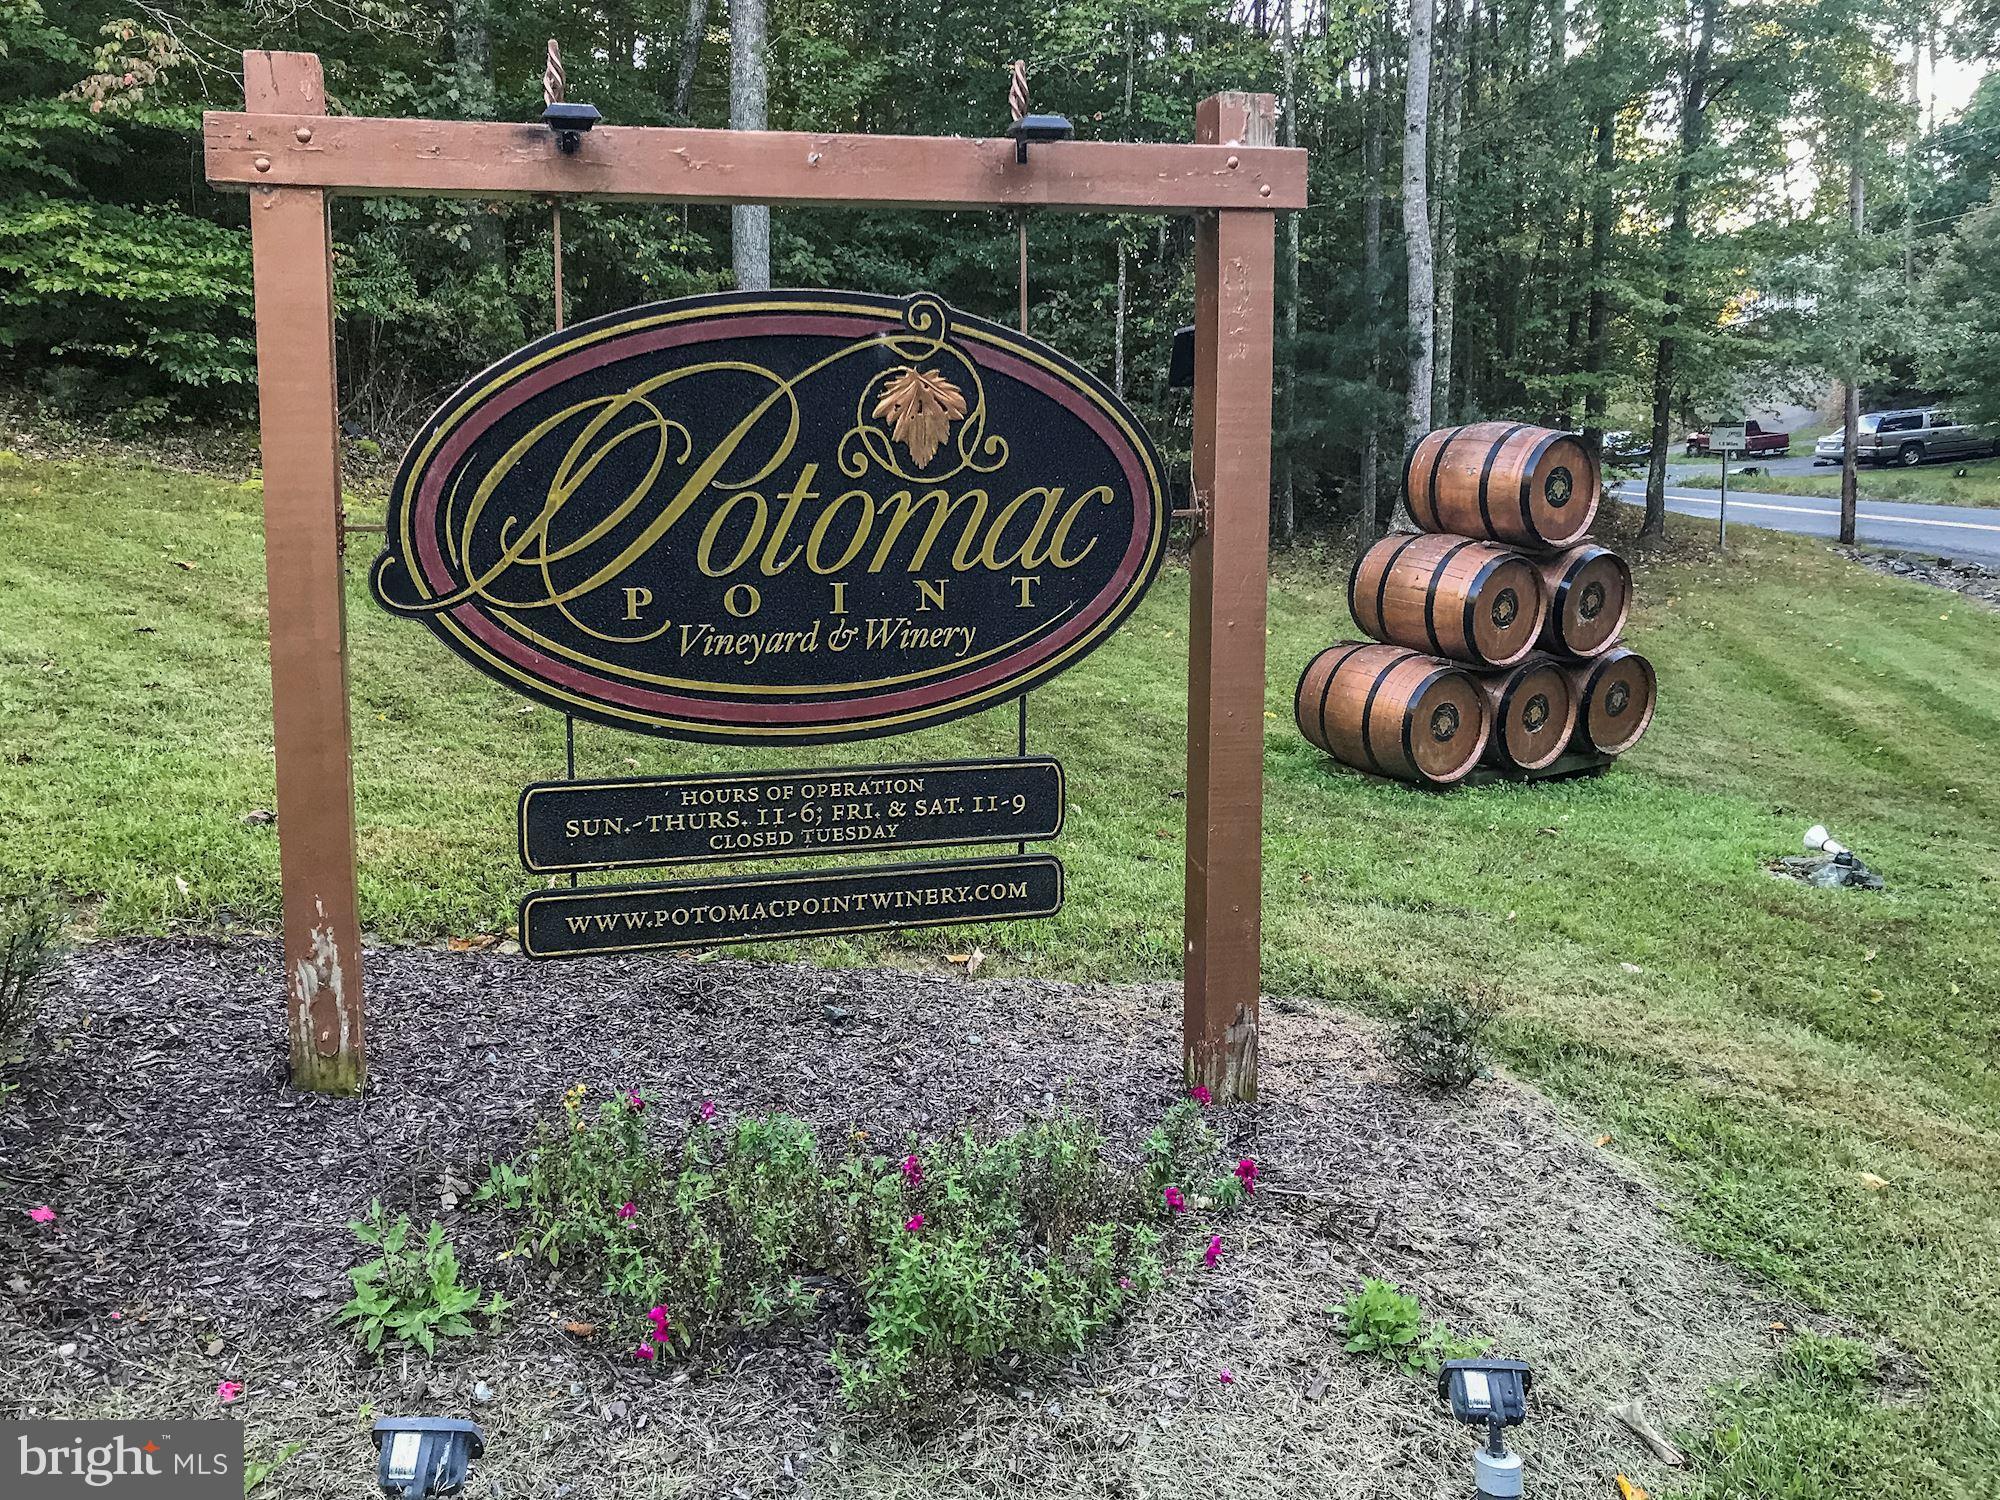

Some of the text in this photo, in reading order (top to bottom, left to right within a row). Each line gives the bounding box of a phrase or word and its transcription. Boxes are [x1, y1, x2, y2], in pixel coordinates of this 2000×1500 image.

[378, 361, 1114, 643] Potomac
[621, 576, 1041, 621] POINT
[678, 618, 977, 665] Vineyard & Winery
[681, 778, 925, 806] HOURS OF OPERATION
[565, 809, 749, 838] SUN.-THURS.
[831, 802, 881, 822] FRI.
[888, 800, 906, 818] &
[914, 797, 965, 817] SAT.
[709, 824, 899, 850] CLOSED TUESDAY
[565, 881, 1028, 935] WWW.POTOMACPOINTWINERY.COM
